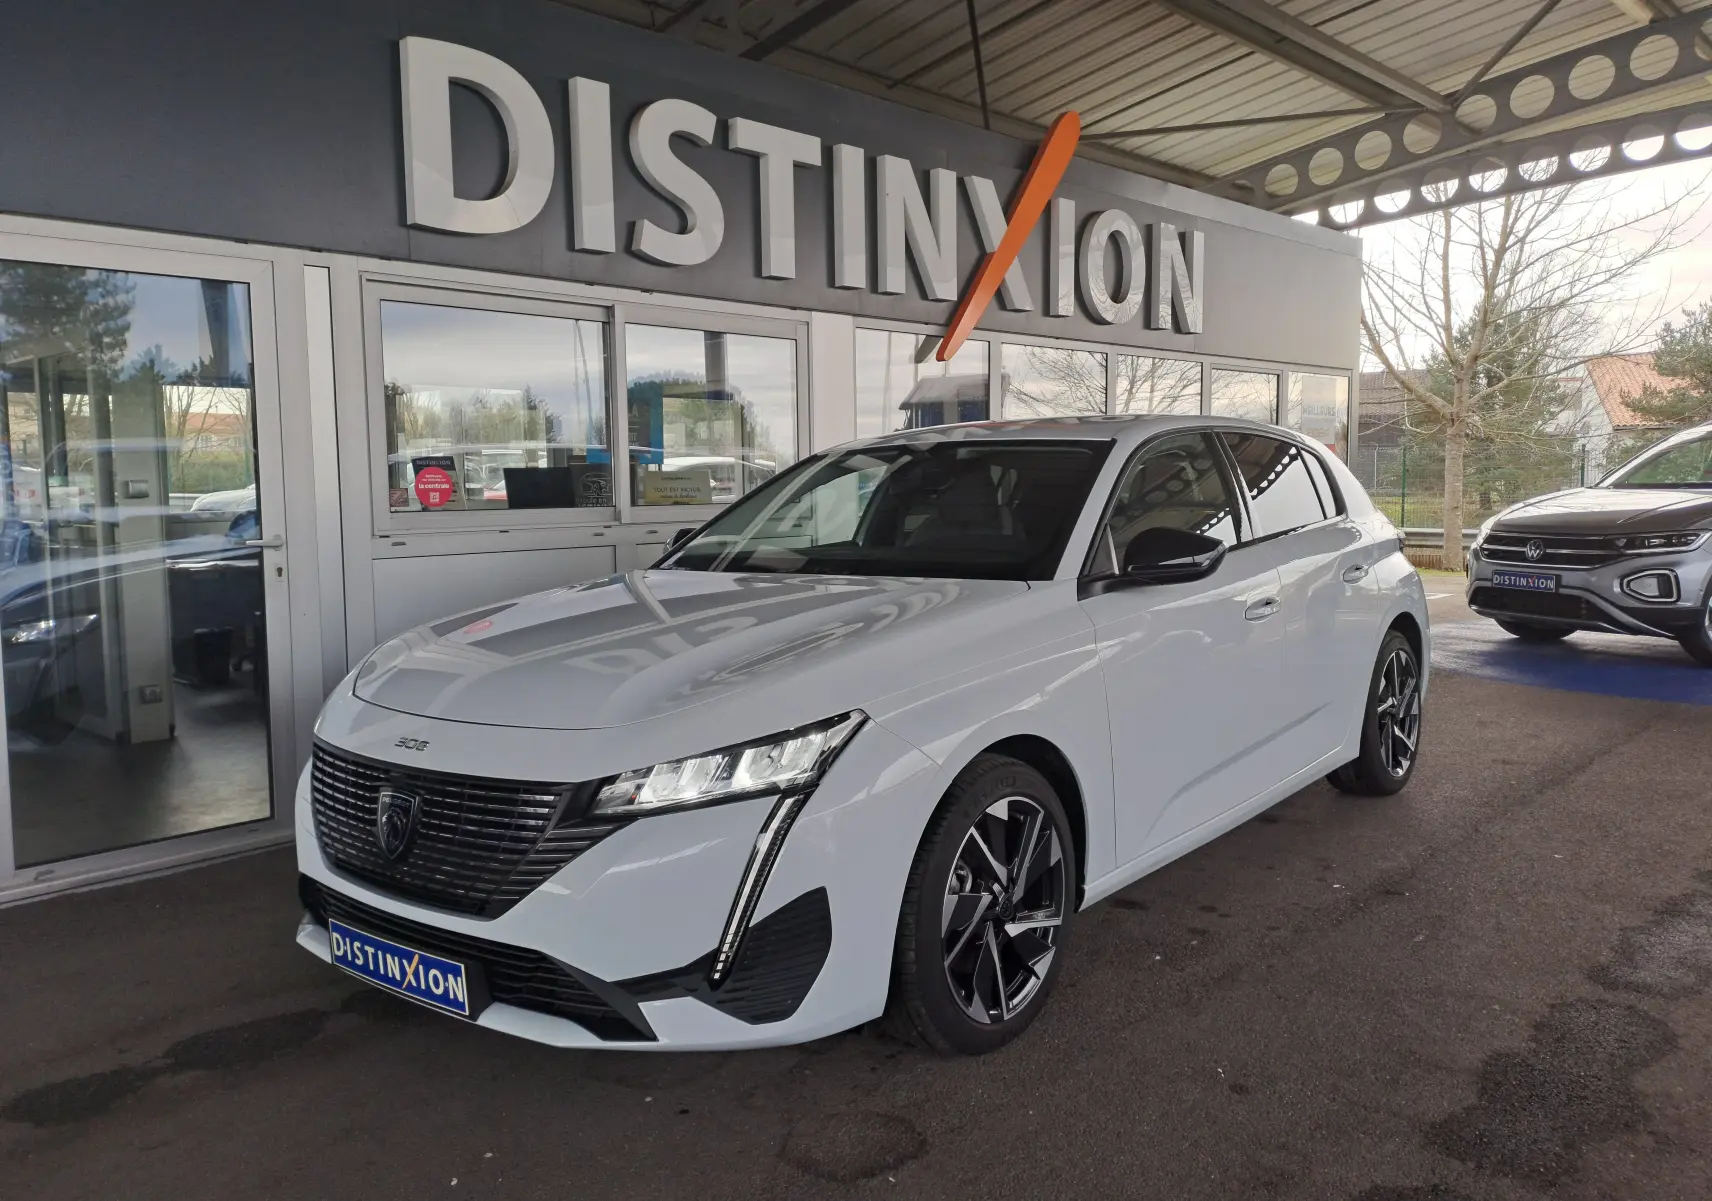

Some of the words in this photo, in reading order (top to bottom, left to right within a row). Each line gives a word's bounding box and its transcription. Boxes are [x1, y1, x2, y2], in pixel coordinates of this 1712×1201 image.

[398, 36, 1205, 361] DISTINXION
[1494, 574, 1554, 588] DISTINXION
[395, 737, 430, 751] 308
[331, 931, 465, 1003] DISTINXION
